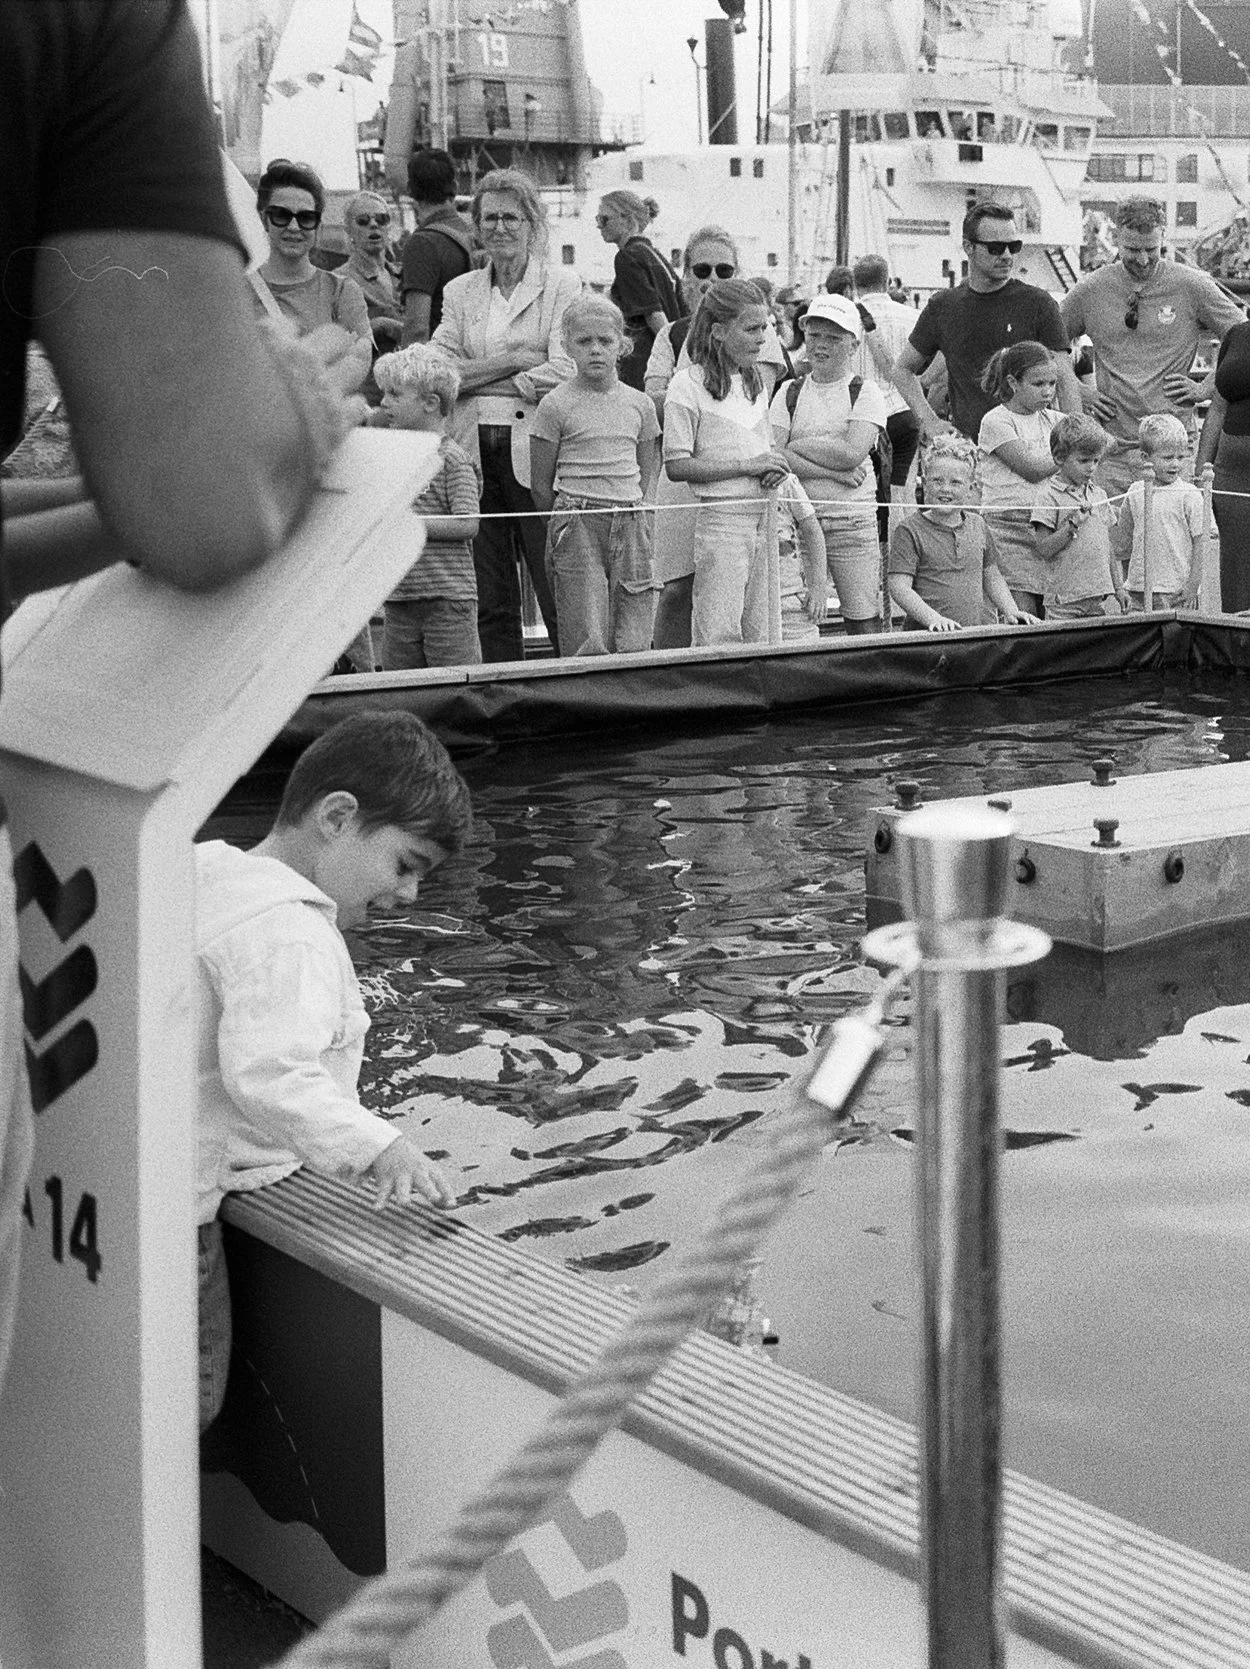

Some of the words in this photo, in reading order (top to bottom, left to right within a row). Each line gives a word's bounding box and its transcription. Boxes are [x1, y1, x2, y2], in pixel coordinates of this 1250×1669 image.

[478, 31, 509, 67] 19
[45, 1175, 102, 1284] 14
[671, 1570, 812, 1669] Po
